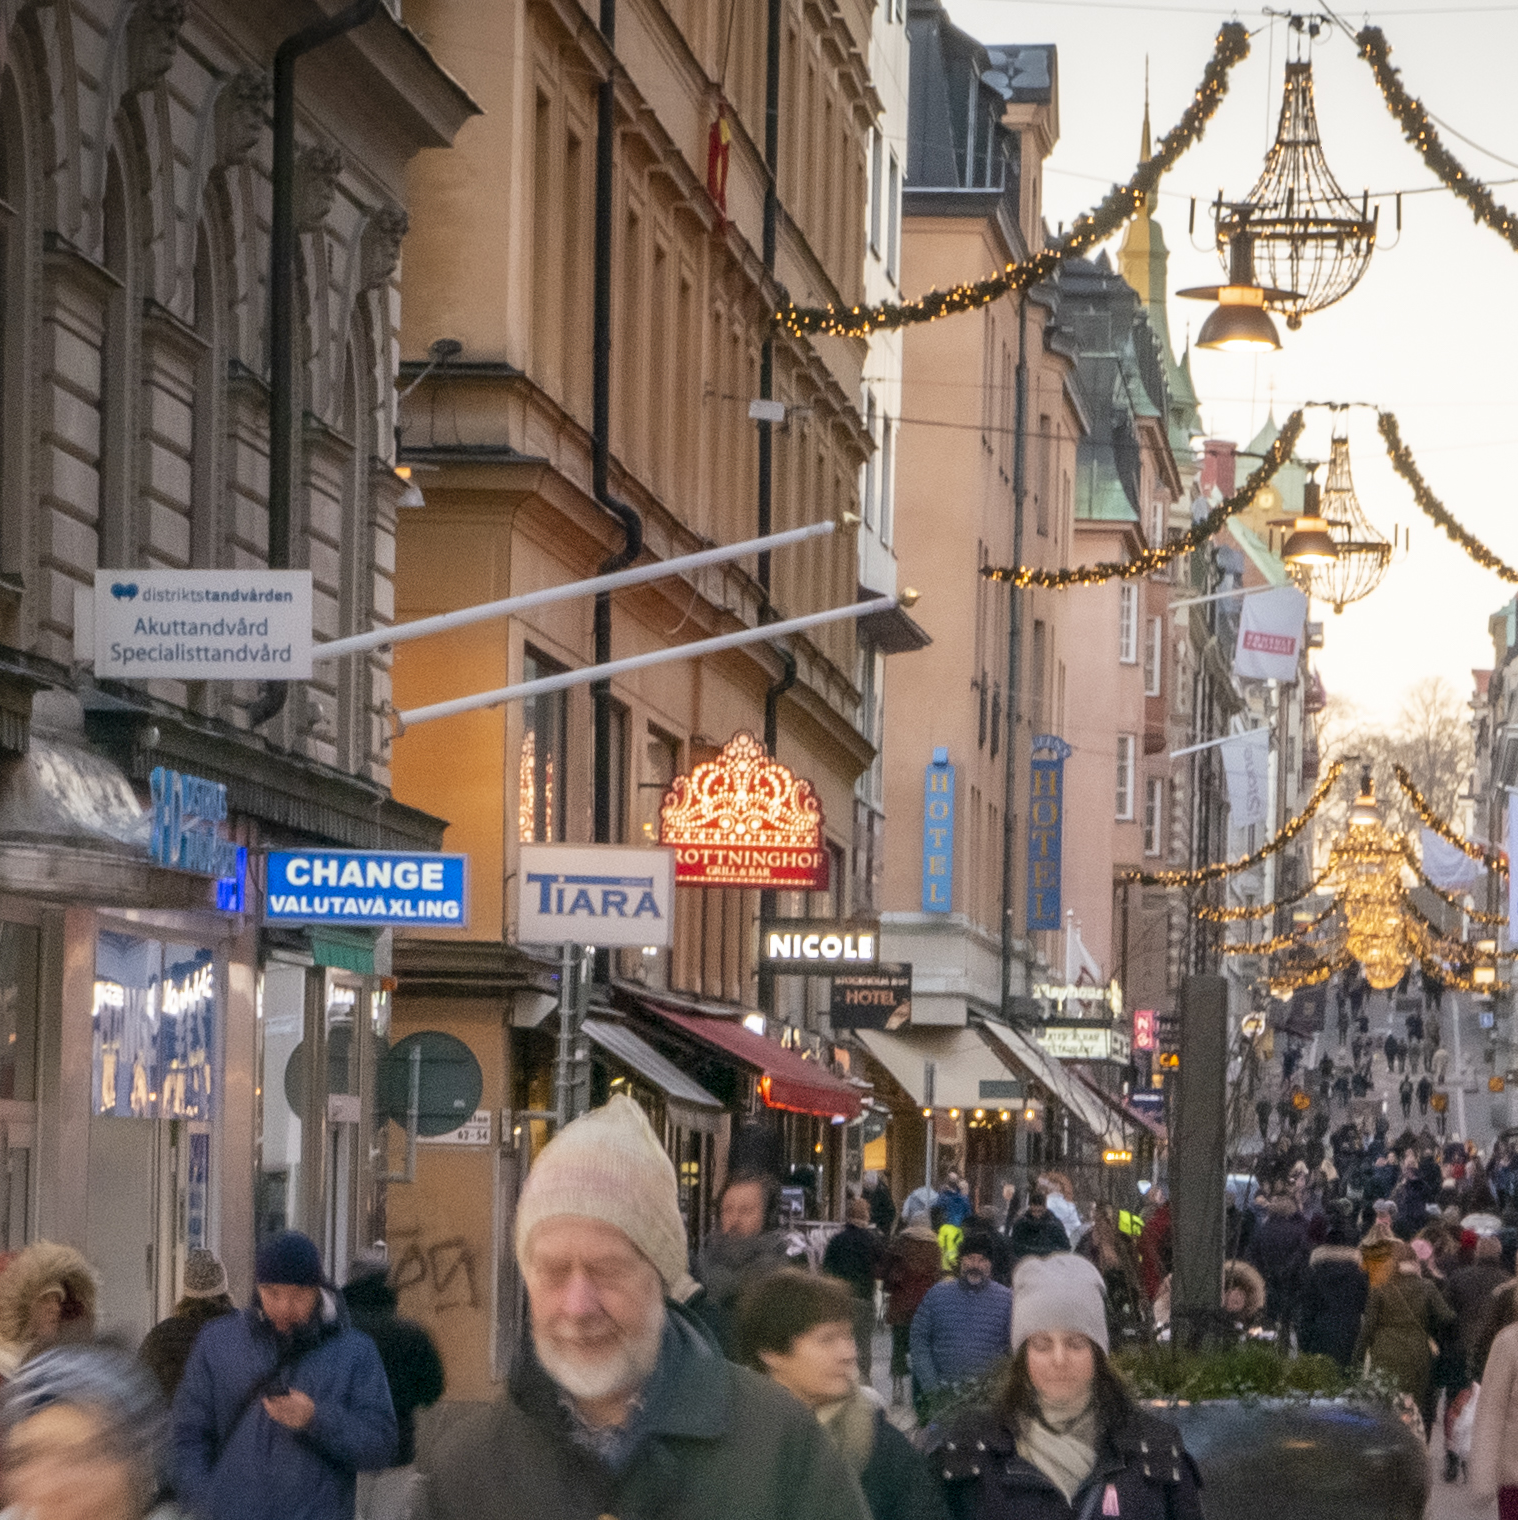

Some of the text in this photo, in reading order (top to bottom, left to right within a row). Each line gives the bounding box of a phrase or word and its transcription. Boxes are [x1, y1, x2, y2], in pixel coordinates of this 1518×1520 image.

[142, 587, 293, 602] distriktstandvården
[134, 617, 269, 637] Akuttandvård
[111, 643, 292, 665] Specialisttandvård
[928, 771, 949, 905] HOTEL
[1031, 769, 1059, 921] HOTEL
[674, 848, 824, 869] ROTTNINGHOF
[284, 858, 445, 891] CHANGE
[705, 866, 736, 876] GRILL
[748, 868, 771, 878] BAR
[269, 894, 461, 920] VALUTAVÄXLING
[768, 933, 875, 959] NICOLE
[844, 989, 897, 1006] HOTEL
[1159, 1052, 1180, 1067] CA
